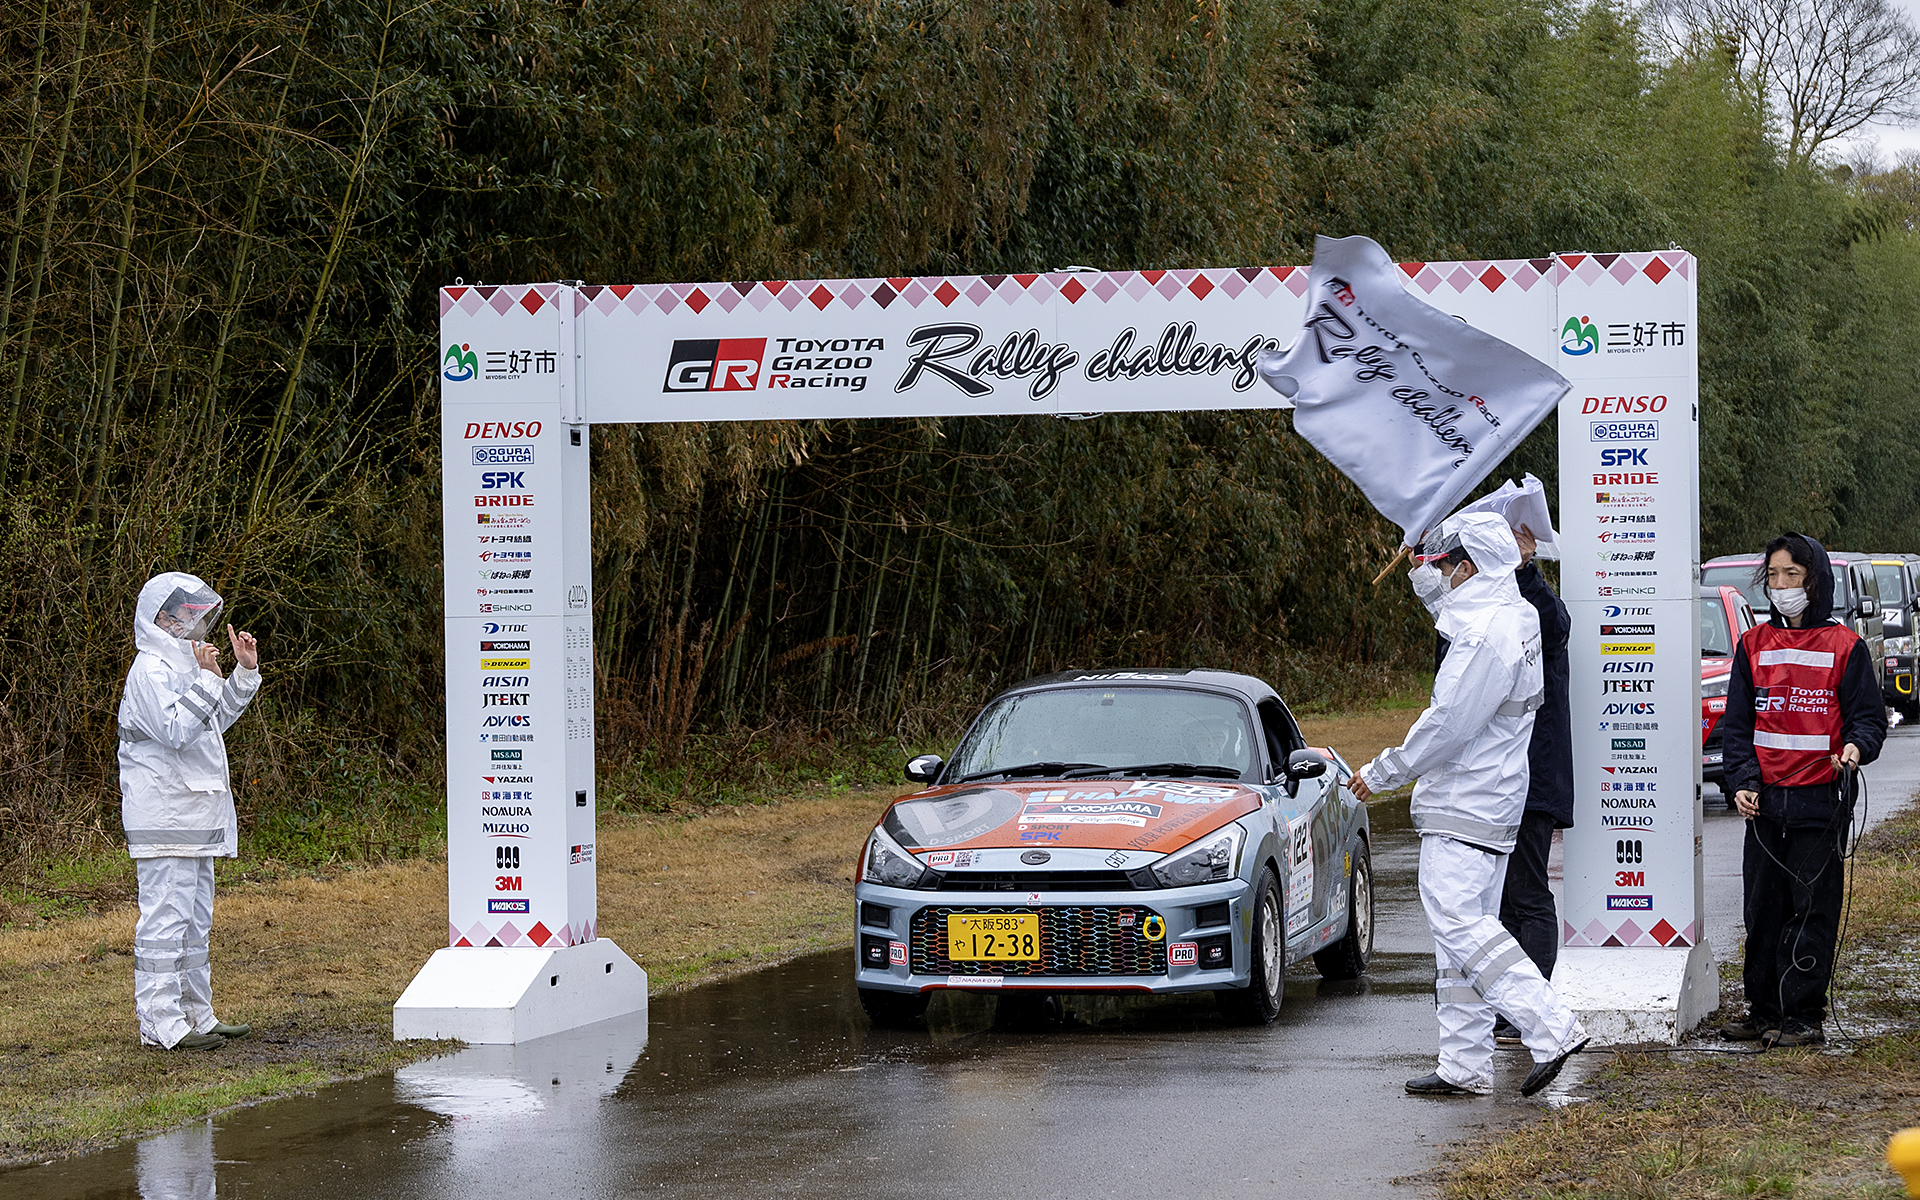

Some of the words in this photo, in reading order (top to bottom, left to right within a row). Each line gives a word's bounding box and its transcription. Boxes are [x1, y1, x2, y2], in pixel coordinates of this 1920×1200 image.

[1607, 321, 1685, 348] 三好市
[775, 338, 885, 353] TOYOTA
[486, 350, 557, 374] 三好市
[772, 355, 875, 372] GAZOO
[894, 321, 1080, 401] Rally
[664, 355, 761, 391] GR
[767, 373, 868, 393] Racing
[1581, 395, 1667, 415] DENSO
[464, 421, 542, 439] DENSO
[1609, 423, 1655, 431] OGURA
[1609, 430, 1655, 439] CLUTCH
[490, 448, 531, 456] OGURA
[1601, 448, 1649, 467] SPK
[490, 455, 531, 463] CLUTCH
[482, 471, 525, 489] SPK
[1592, 472, 1659, 486] BRIDE
[474, 495, 534, 507] BRIDE
[1612, 587, 1656, 595] SHINKO
[492, 604, 532, 612] SHINKO
[1622, 607, 1653, 615] TTDC
[500, 624, 528, 632] TTDC
[1613, 626, 1654, 634] YOKOHAMA
[493, 642, 529, 650] YOKOHAMA
[1602, 661, 1654, 673] AISIN
[482, 676, 529, 687] AISIN
[1602, 679, 1656, 696] JTEKT
[482, 693, 530, 709] JTEKT
[1602, 702, 1655, 715] ADVICS
[482, 715, 530, 727] ADVICS
[1613, 740, 1644, 748] MS&AD
[493, 751, 521, 759] MS&AD
[1618, 766, 1657, 774] YAZAKI
[497, 776, 533, 784] YAZAKI
[1612, 782, 1657, 792] 東海理化
[492, 791, 532, 800] 東海理化
[1068, 788, 1160, 801] HALF
[1162, 792, 1236, 805] WAY
[1060, 803, 1153, 816] YOKOHAMA
[1601, 798, 1657, 809] NOMURA
[482, 806, 533, 817] NOMURA
[1601, 815, 1653, 826] MIZUHO
[482, 823, 529, 833] MIZUHO
[928, 824, 991, 846] D-SPORT
[1019, 832, 1063, 841] SPK
[1105, 849, 1130, 869] GET
[1127, 829, 1161, 851] YOUR
[1293, 821, 1307, 867] 122
[495, 876, 522, 891] 3M
[1615, 871, 1645, 887] 3M
[955, 939, 966, 951] や
[972, 933, 1034, 957] 12-38
[890, 948, 903, 960] PRO
[1174, 948, 1193, 960] PRO
